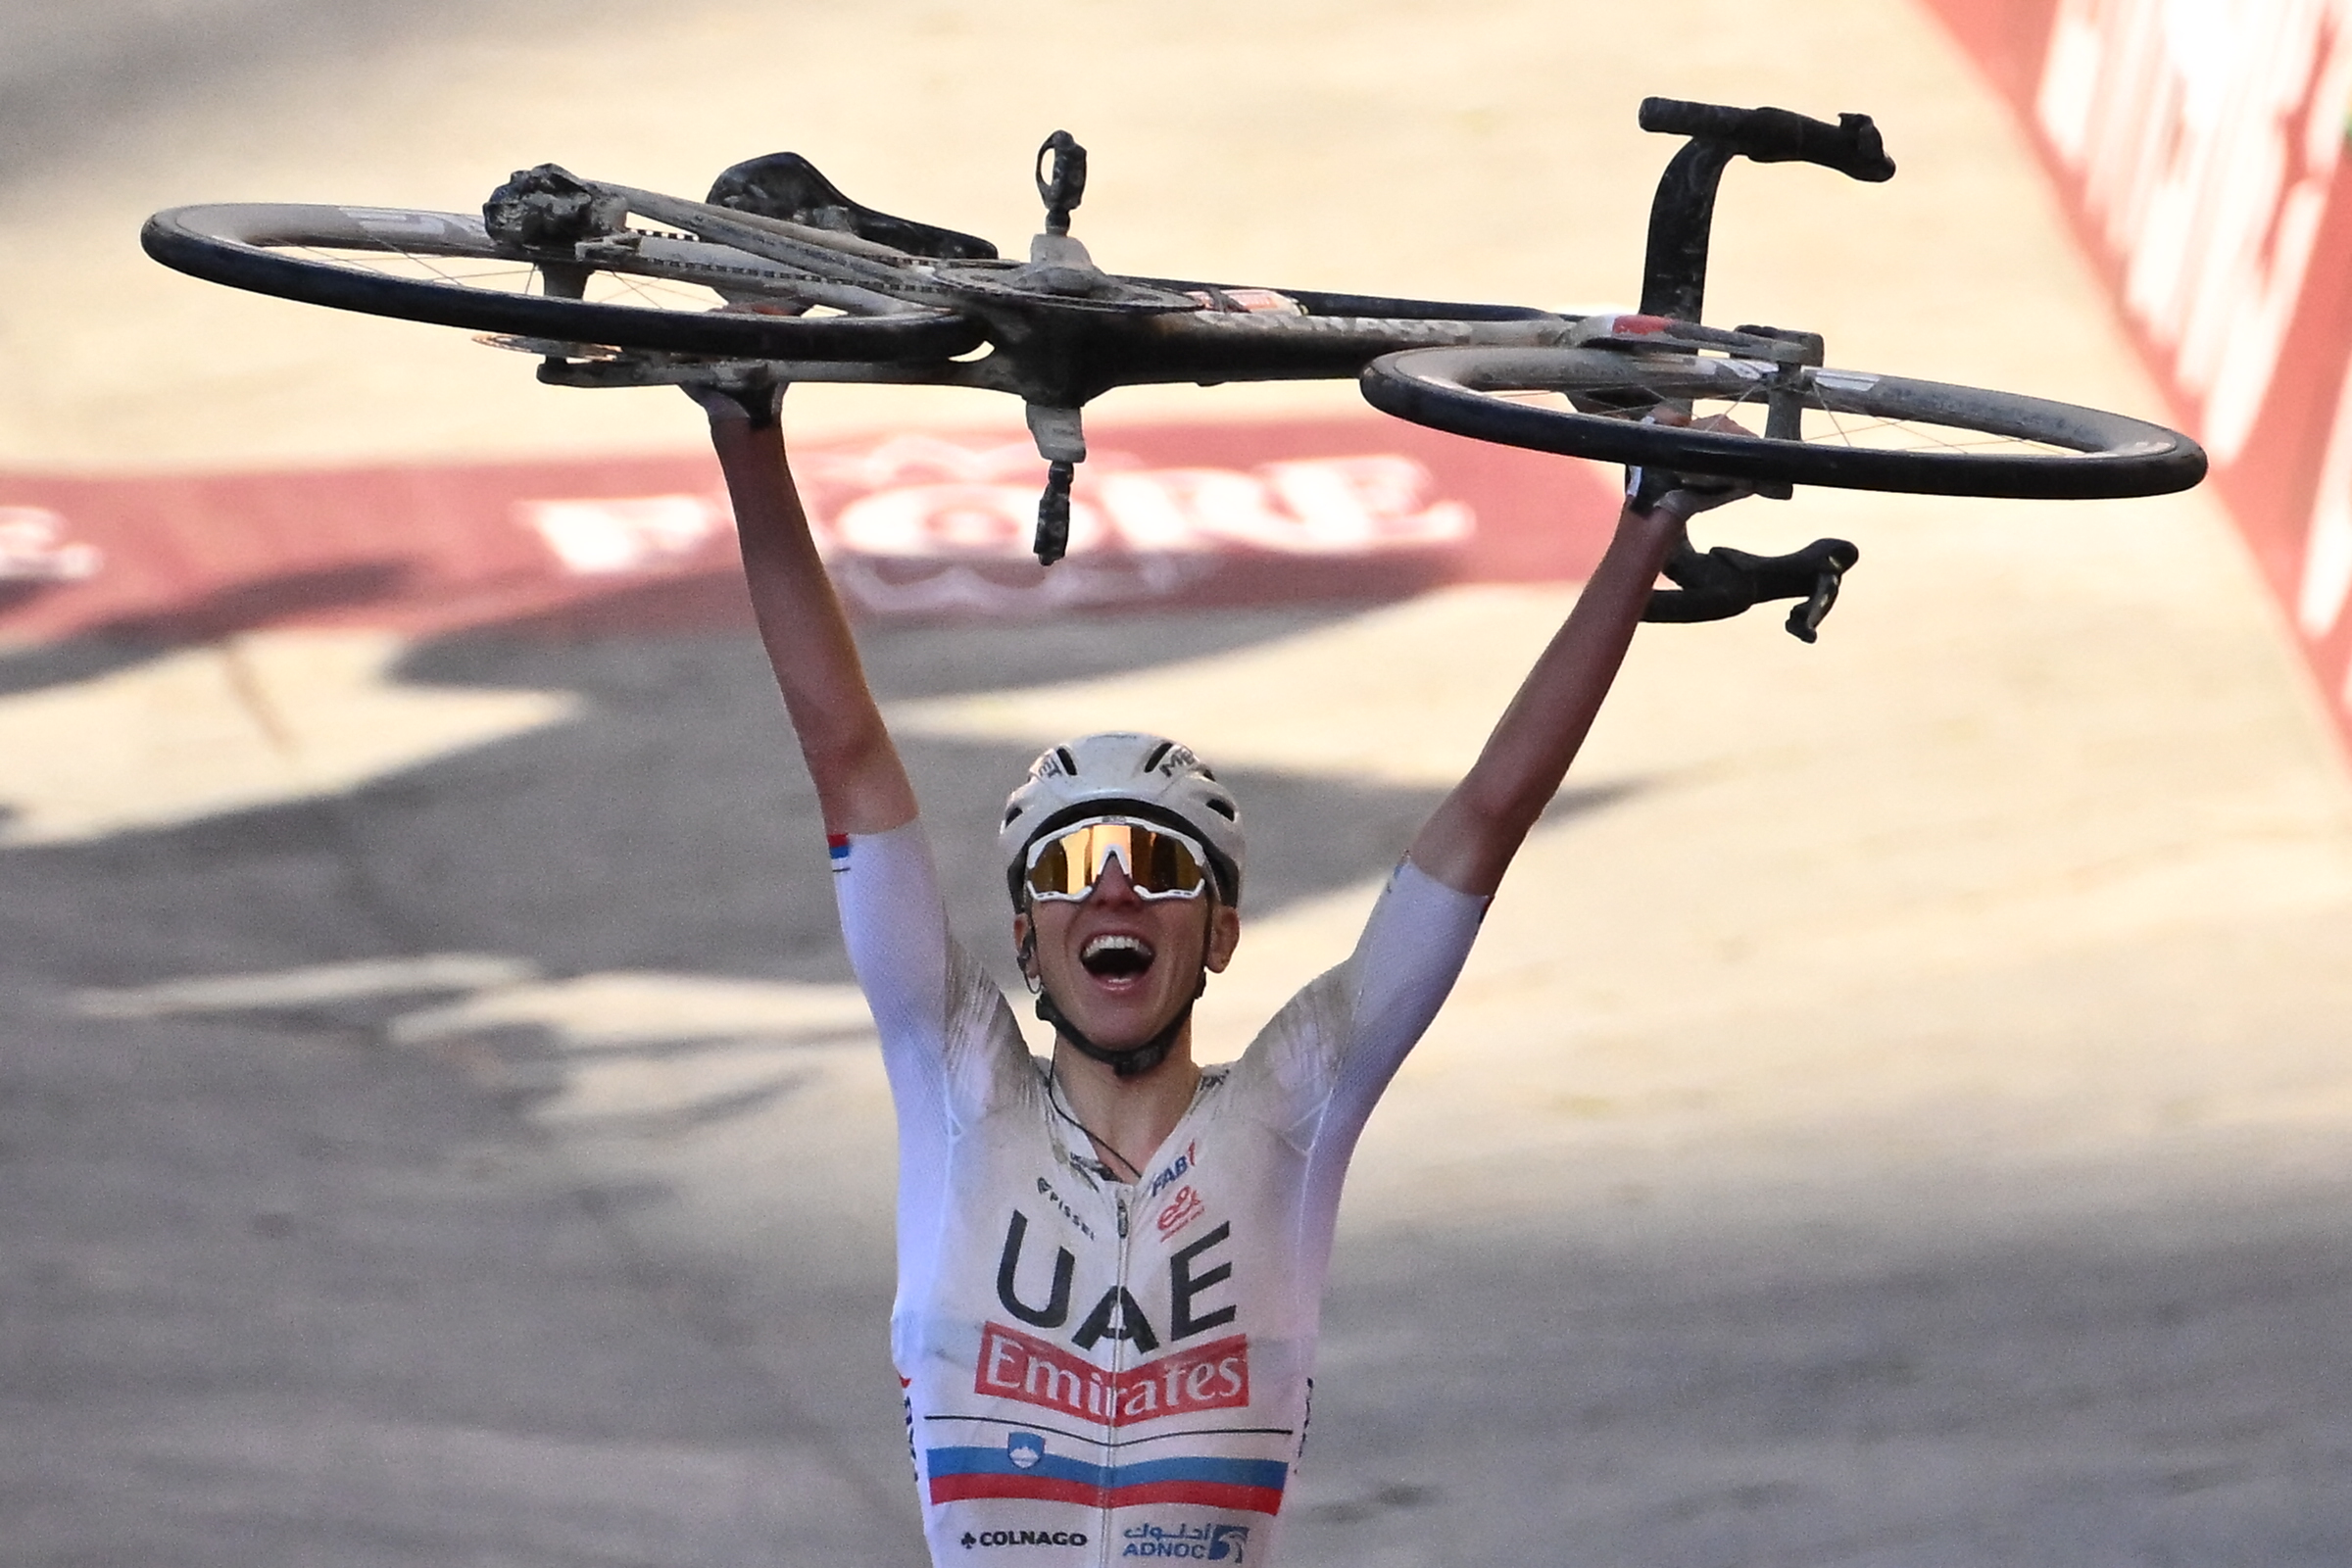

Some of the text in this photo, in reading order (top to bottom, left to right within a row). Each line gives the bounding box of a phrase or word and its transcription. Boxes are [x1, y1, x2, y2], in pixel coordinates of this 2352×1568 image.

[997, 1208, 1237, 1354] UAE
[985, 1333, 1245, 1417] Emirates
[980, 1531, 1088, 1547] COLNAGO
[1122, 1542, 1208, 1559] ADNOC
